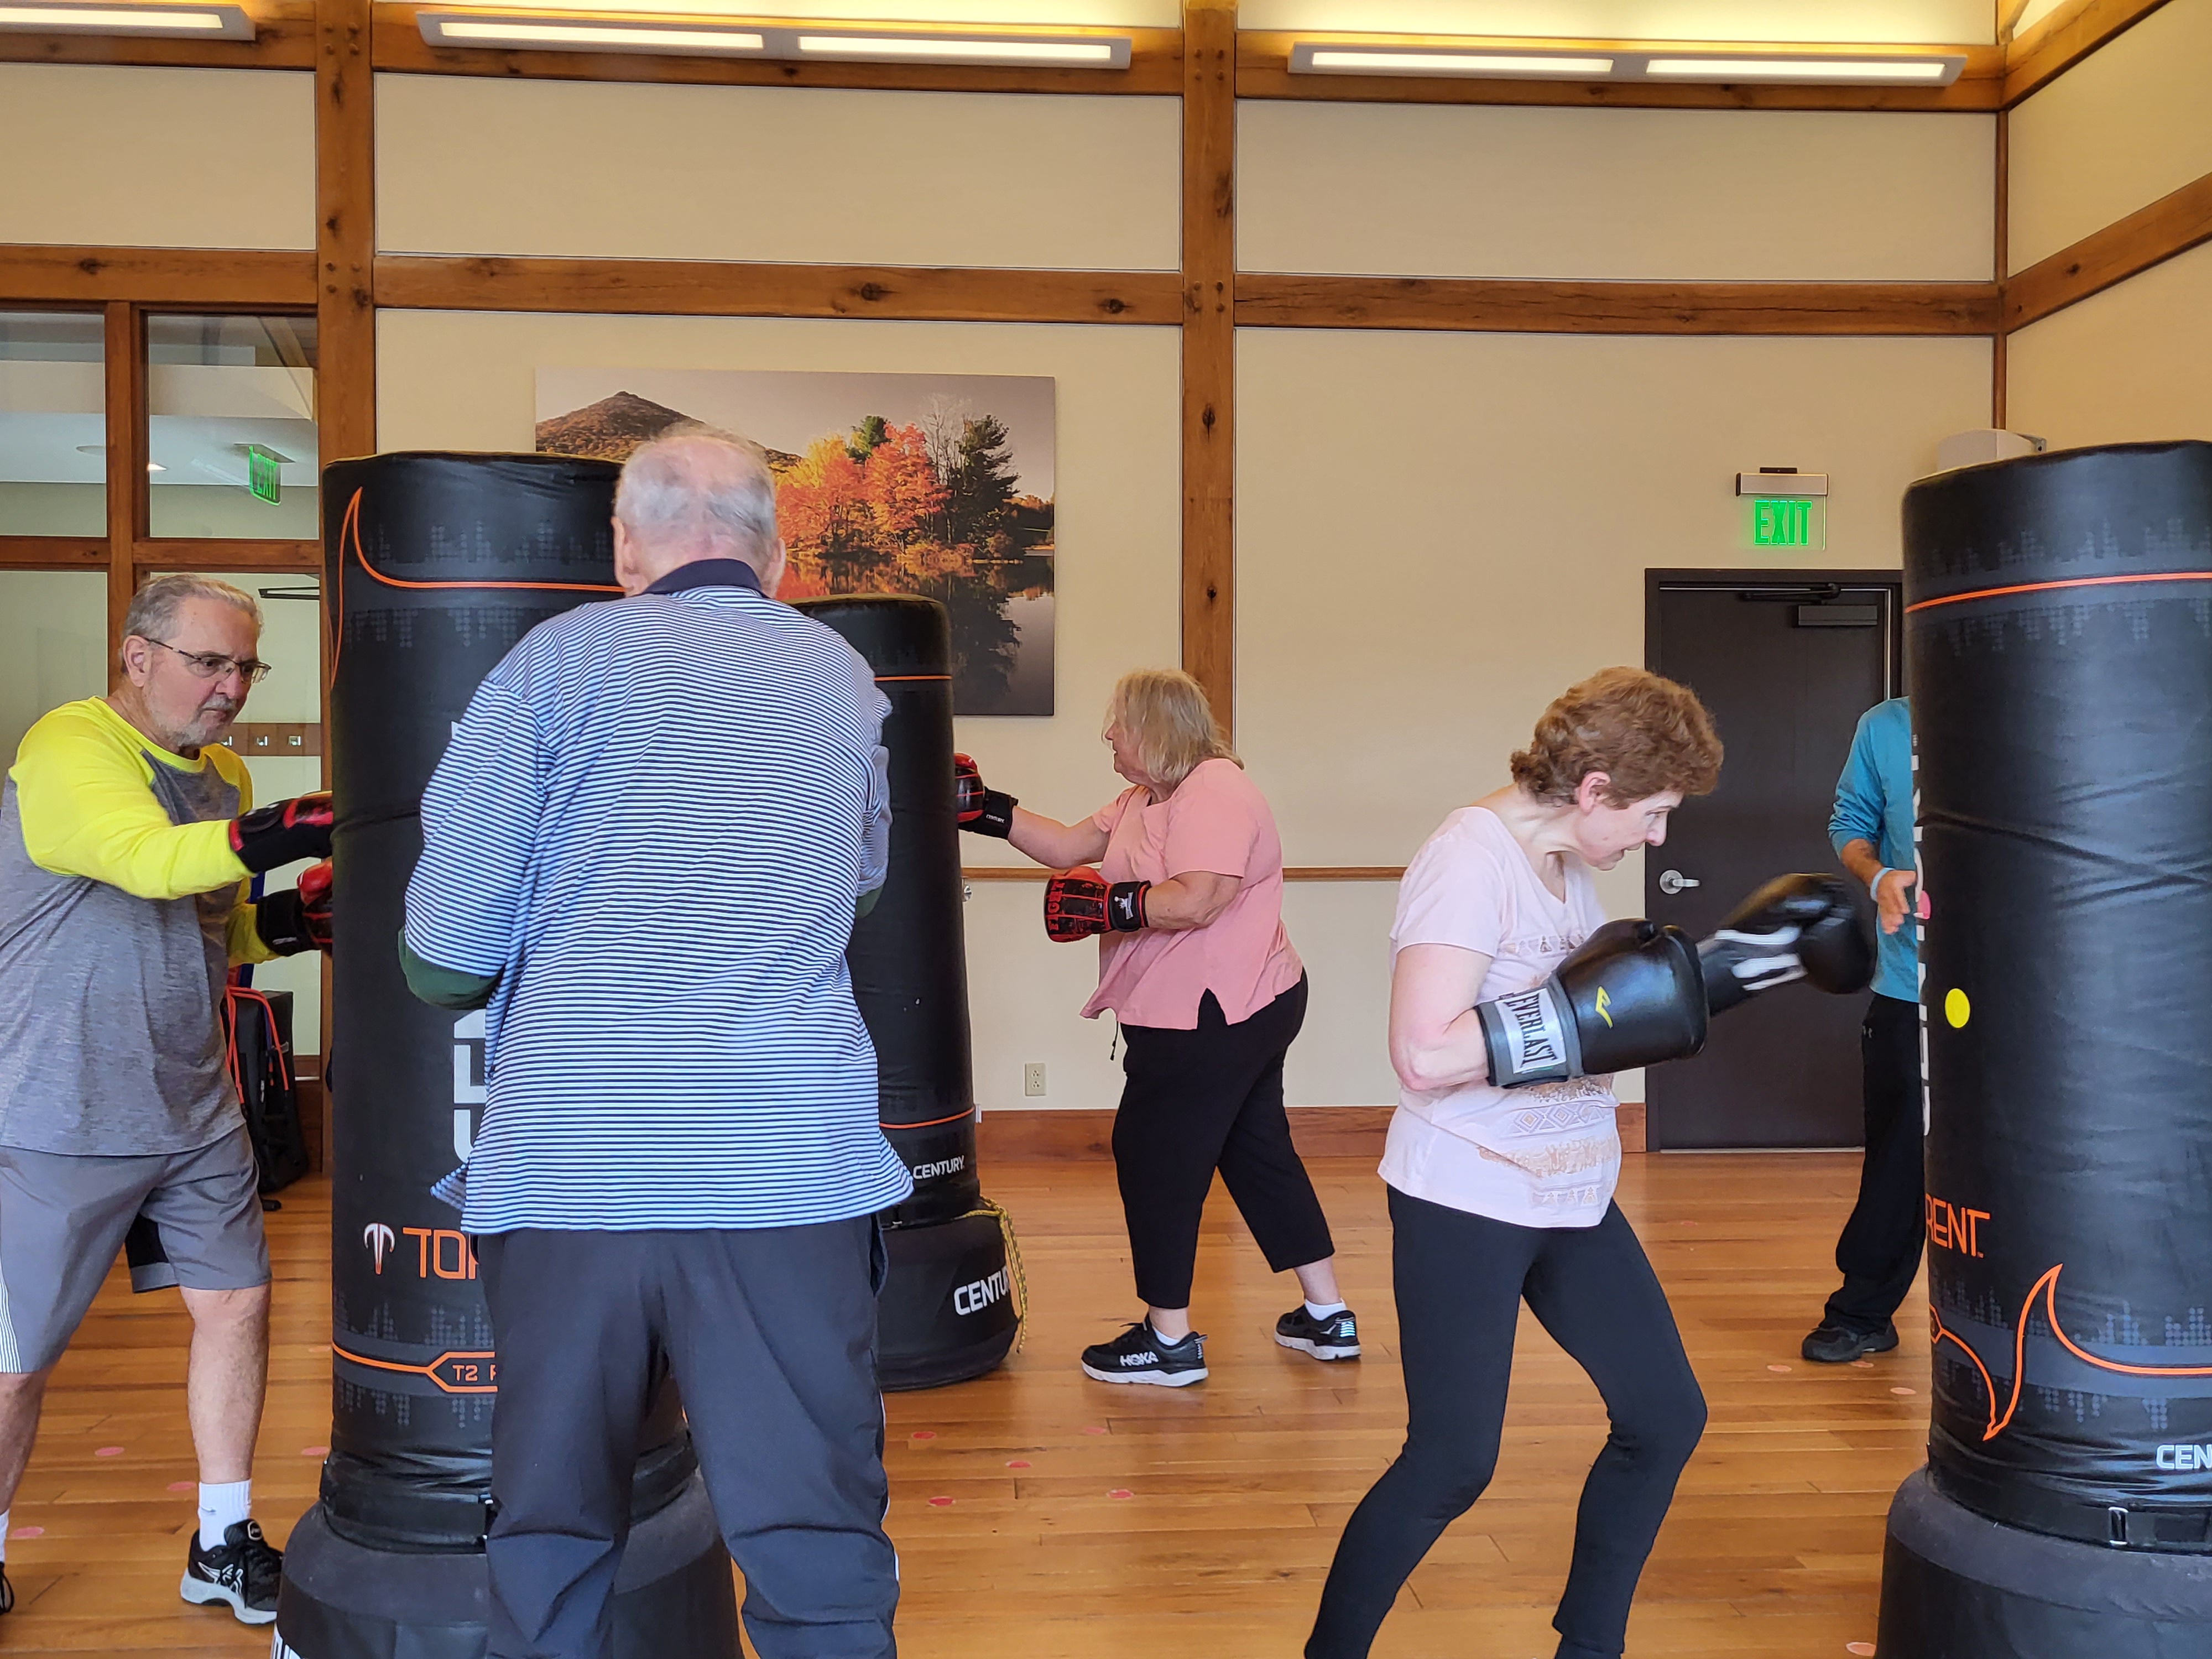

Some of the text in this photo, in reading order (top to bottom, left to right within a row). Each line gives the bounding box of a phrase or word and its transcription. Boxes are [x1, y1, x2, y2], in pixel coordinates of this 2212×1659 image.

[1754, 499, 1812, 546] EXIT
[1503, 993, 1558, 1068] EVERLAST
[912, 1155, 965, 1180] CENTURY
[1119, 1350, 1159, 1367] HOKA
[452, 1364, 478, 1381] T2
